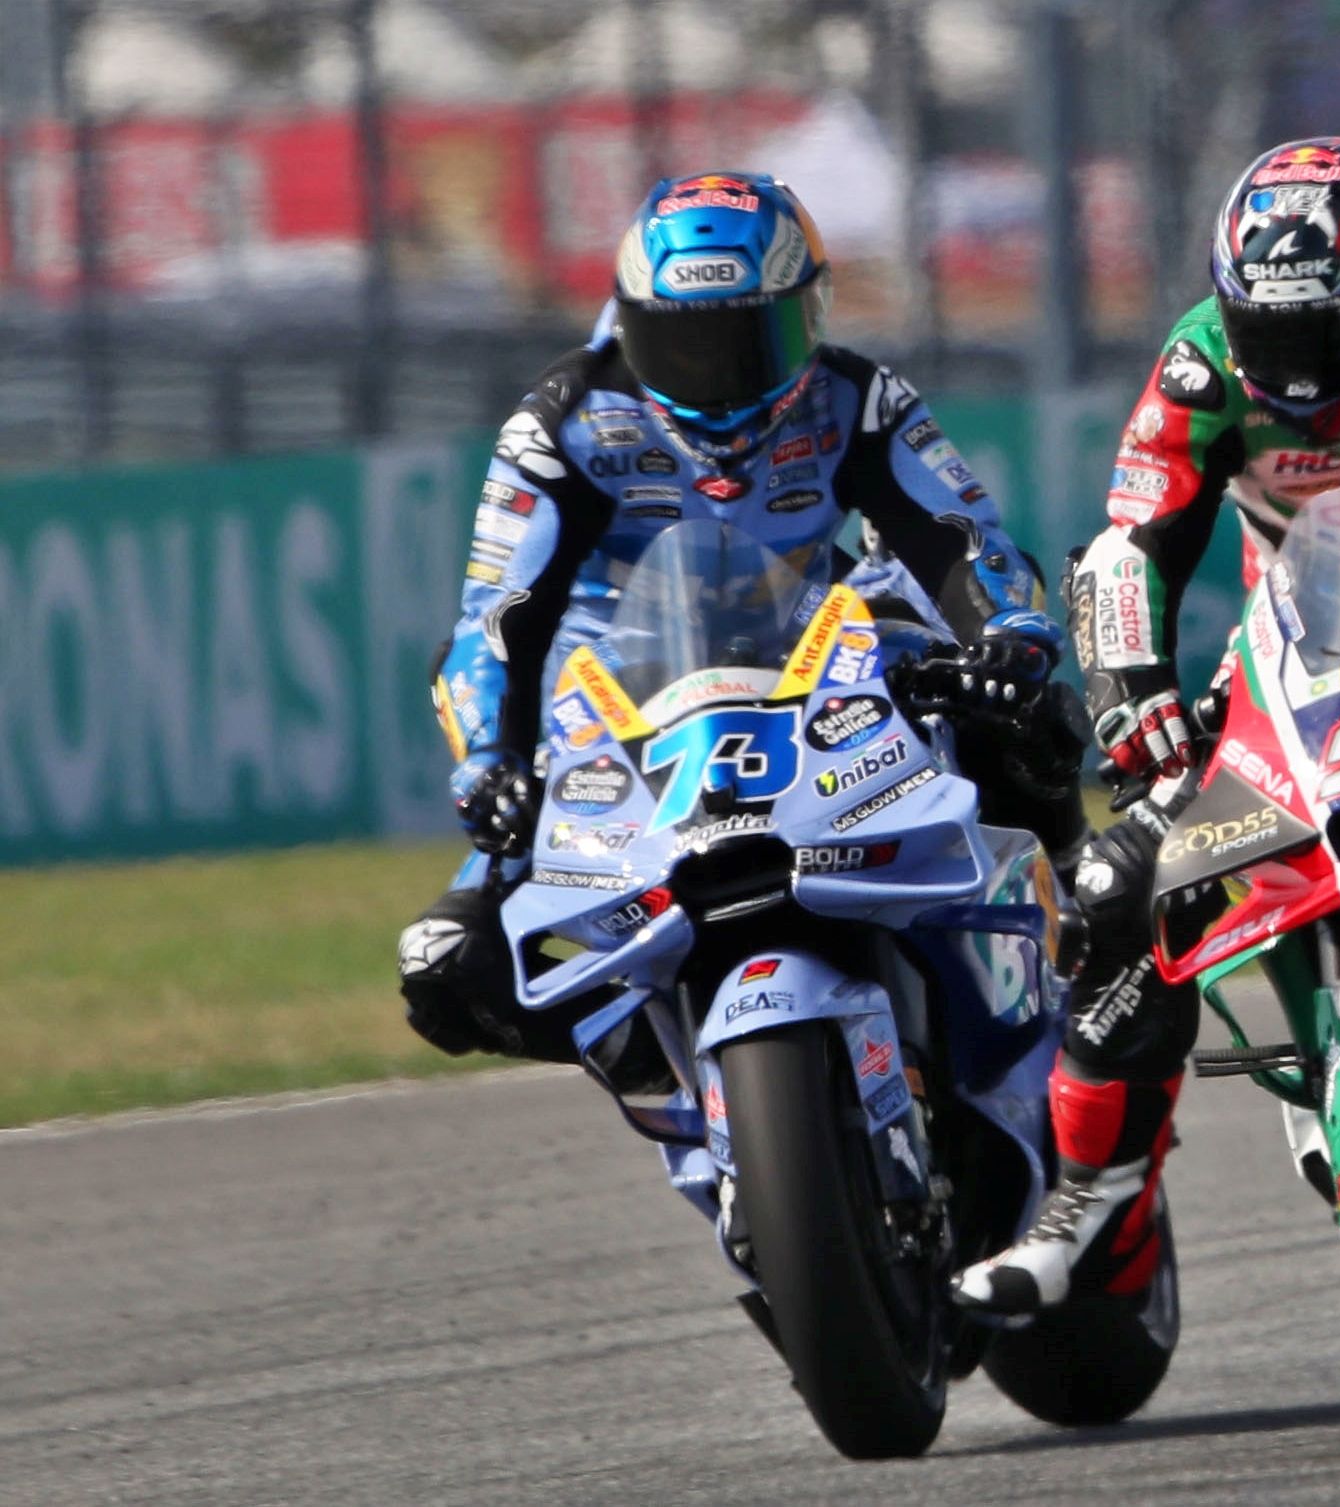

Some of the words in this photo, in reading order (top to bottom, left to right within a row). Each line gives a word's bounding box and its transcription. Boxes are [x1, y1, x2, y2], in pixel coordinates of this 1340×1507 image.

[674, 262, 736, 284] SHOEI
[1243, 258, 1333, 281] SHARK
[1118, 581, 1145, 655] Castrol
[812, 698, 876, 733] Estrella
[822, 709, 883, 746] Galicia
[641, 705, 804, 839] 73
[814, 738, 908, 799] Unibat
[1220, 738, 1294, 807] SENA
[798, 847, 865, 867] BOLD
[1211, 826, 1279, 858] SPORTS
[600, 902, 644, 933] BOLD
